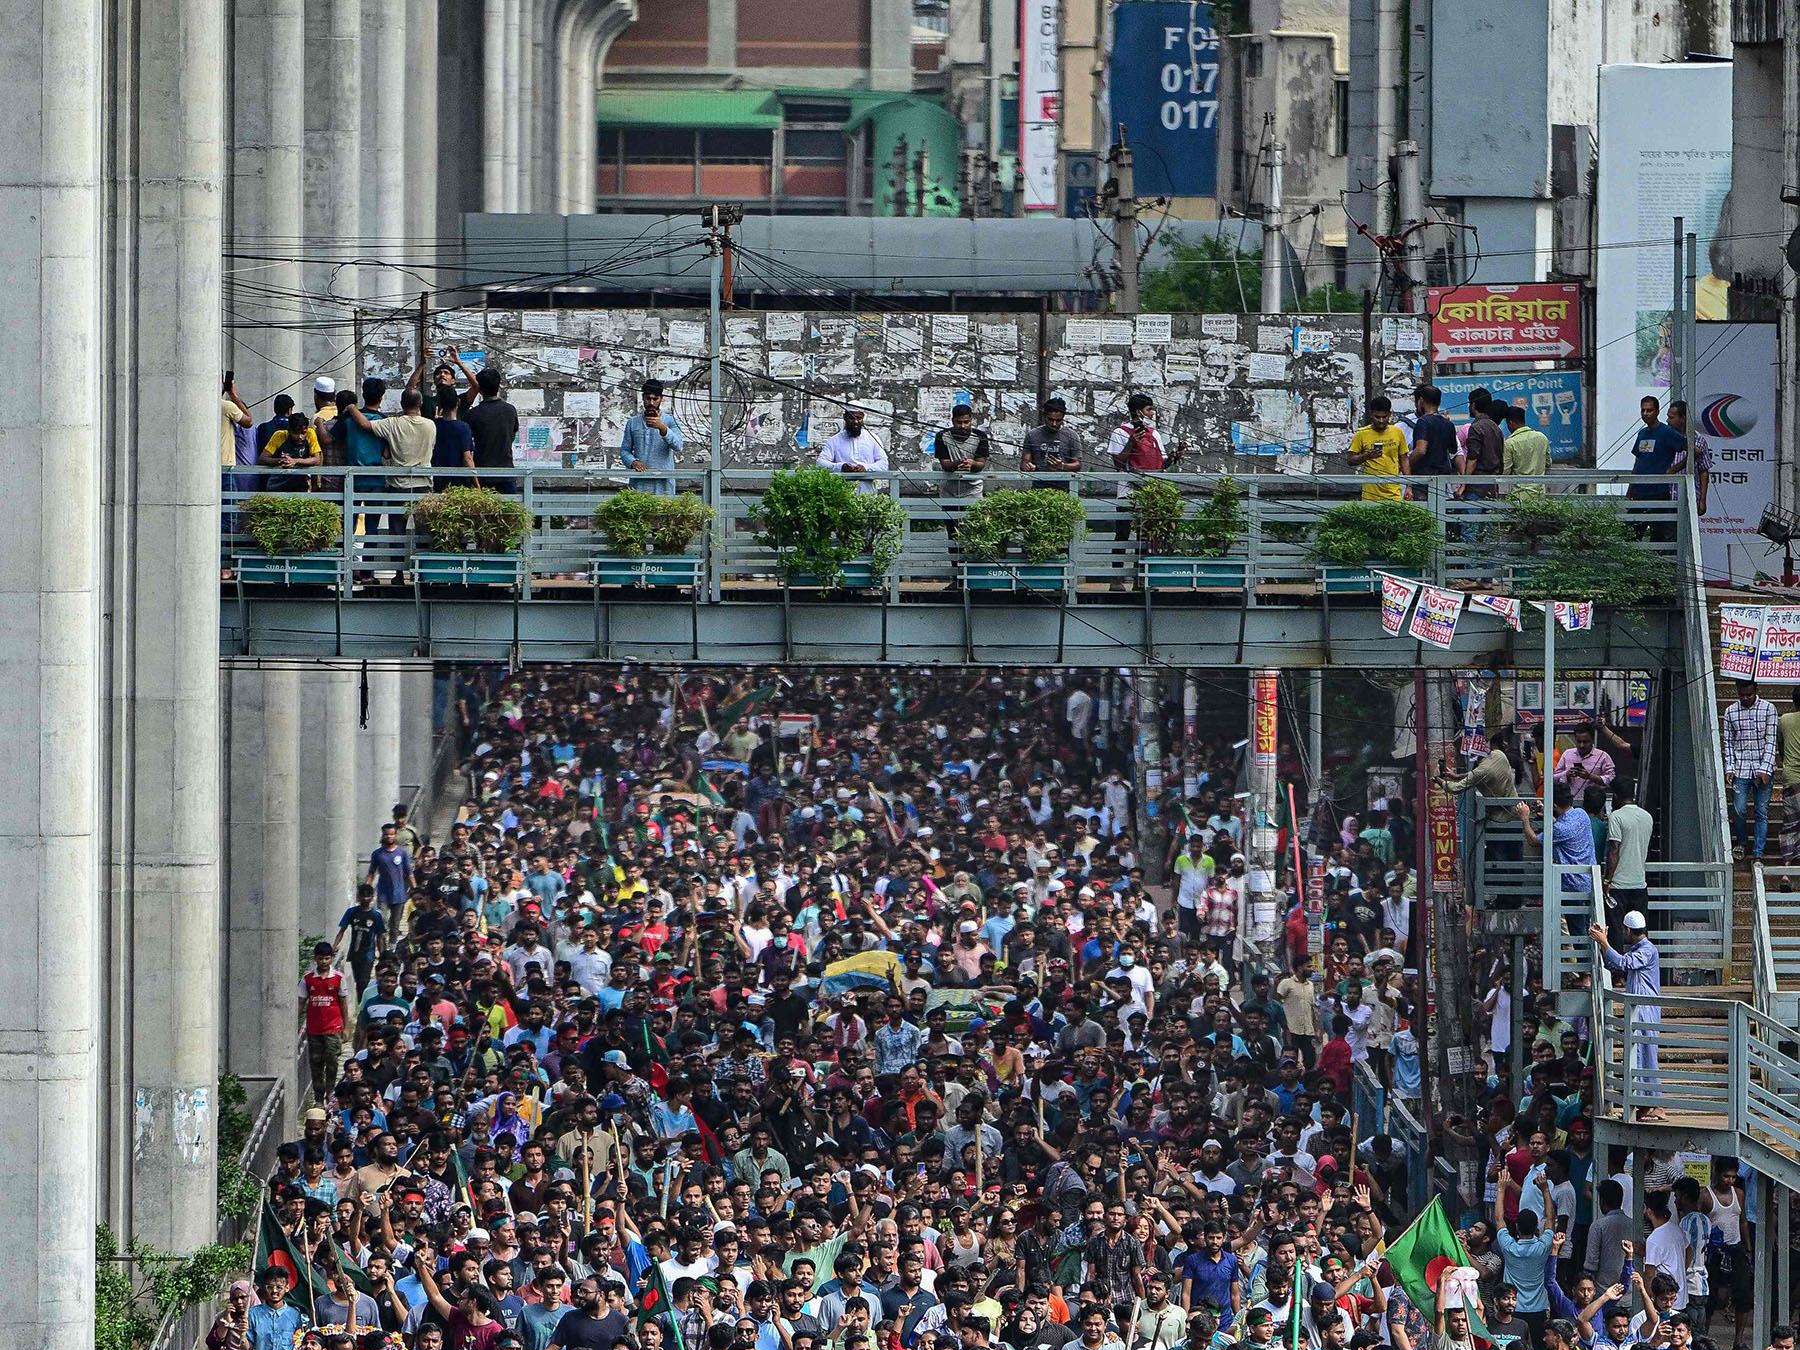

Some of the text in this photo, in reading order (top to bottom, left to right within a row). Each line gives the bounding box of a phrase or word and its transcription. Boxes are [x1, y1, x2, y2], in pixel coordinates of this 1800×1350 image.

[1161, 101, 1219, 129] 017
[1437, 294, 1571, 323] কোরিয়ান
[1448, 322, 1560, 341] কালচার এইড
[1492, 378, 1524, 391] Care
[1527, 377, 1563, 389] Point
